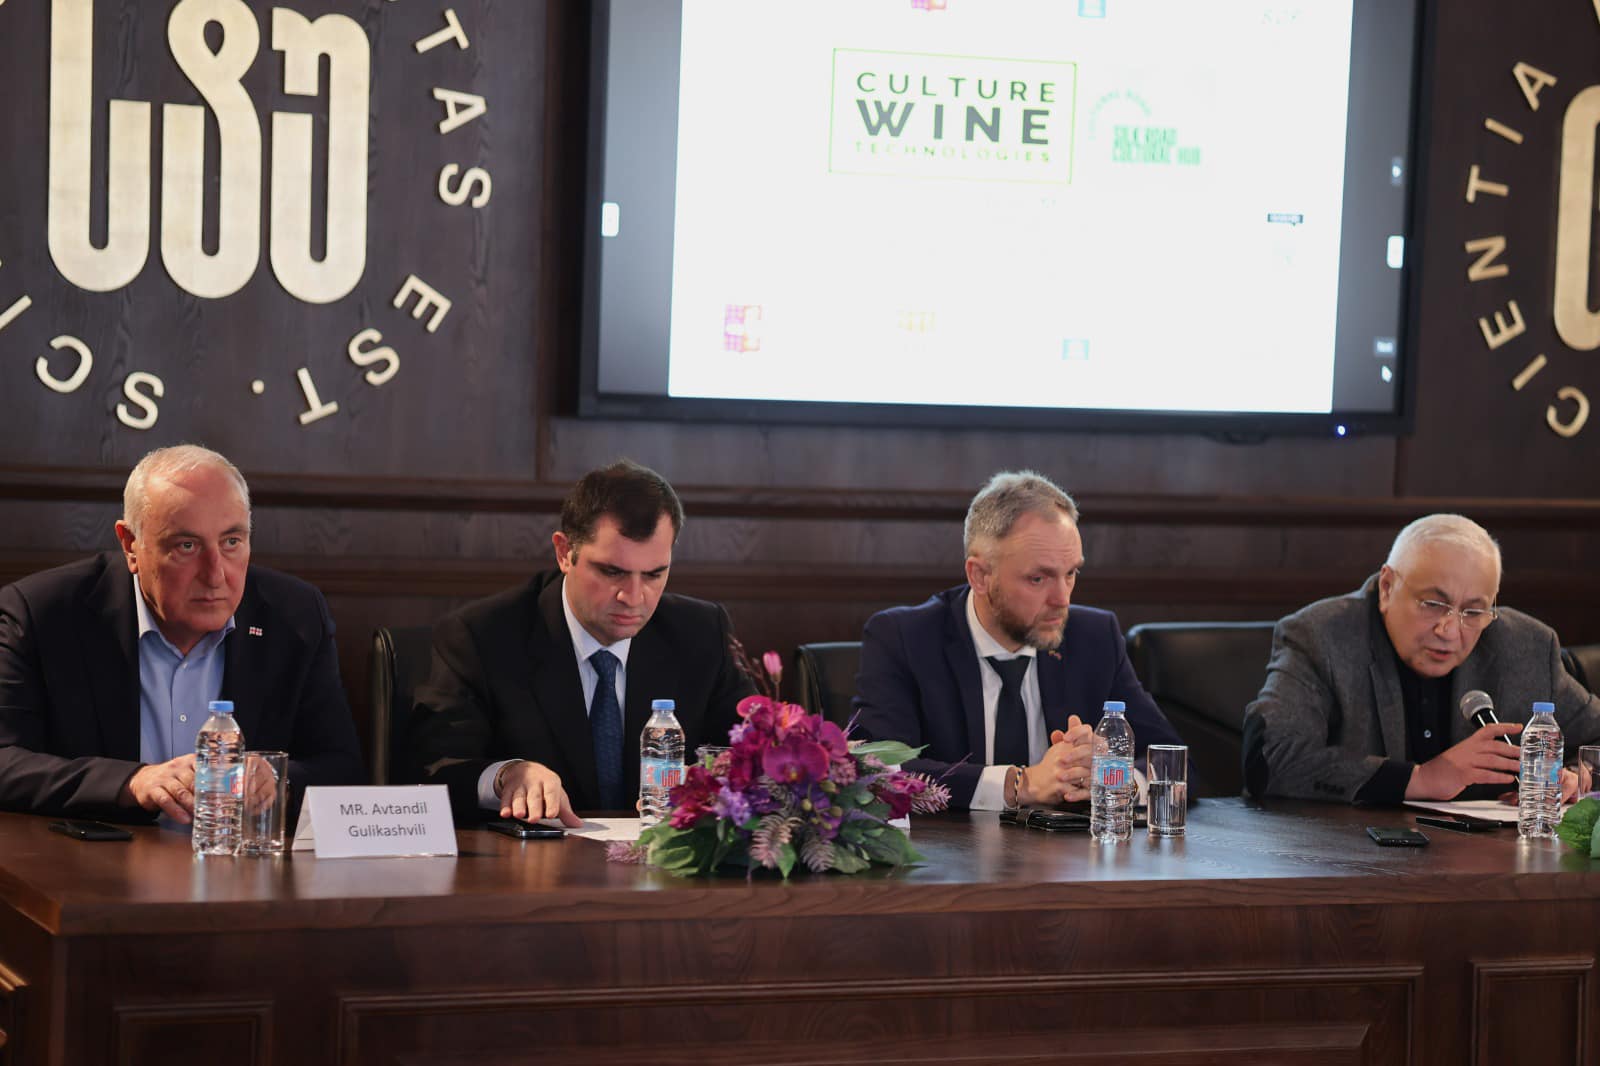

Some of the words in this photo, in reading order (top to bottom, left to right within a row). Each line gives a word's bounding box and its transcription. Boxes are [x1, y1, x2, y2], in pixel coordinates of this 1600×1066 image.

[856, 72, 1056, 103] CULTURE
[386, 0, 493, 209] TAS
[855, 99, 1050, 145] WINE
[855, 141, 1051, 163] TECHNOLOGIES
[1465, 61, 1590, 437] CIENTIA
[340, 803, 368, 816] MR.
[372, 802, 428, 815] Avtandil
[348, 823, 426, 837] Gulikashvili
